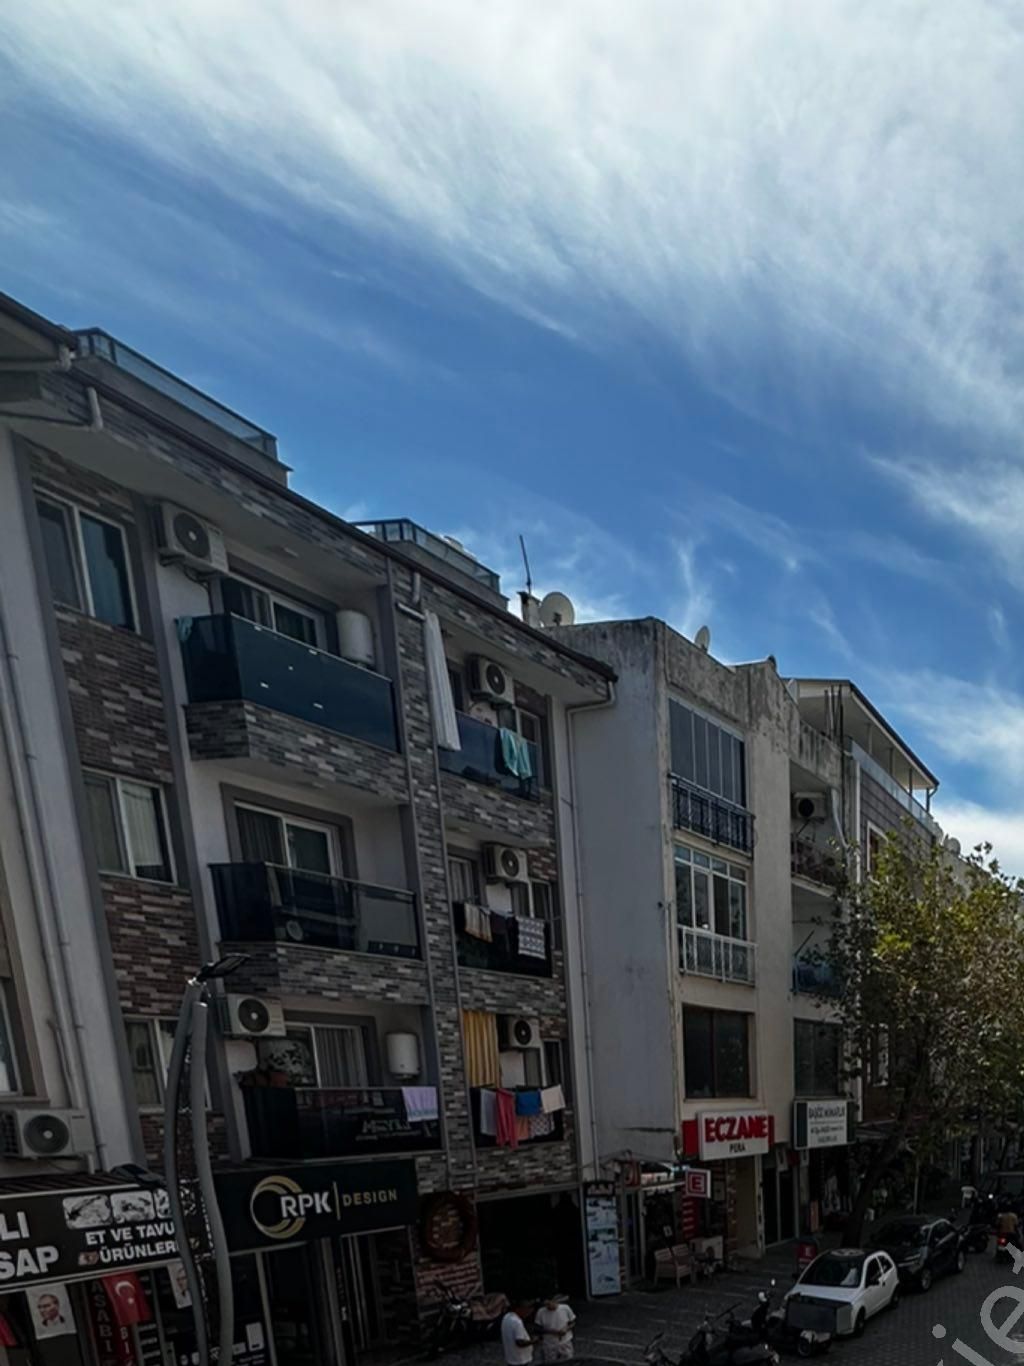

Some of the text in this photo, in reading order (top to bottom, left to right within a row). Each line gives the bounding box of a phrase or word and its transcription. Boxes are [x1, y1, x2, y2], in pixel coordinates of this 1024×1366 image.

[704, 1115, 769, 1143] ECZANE
[280, 1189, 398, 1218] RPK DESIGN
[85, 1221, 176, 1245] ET VE TAVU
